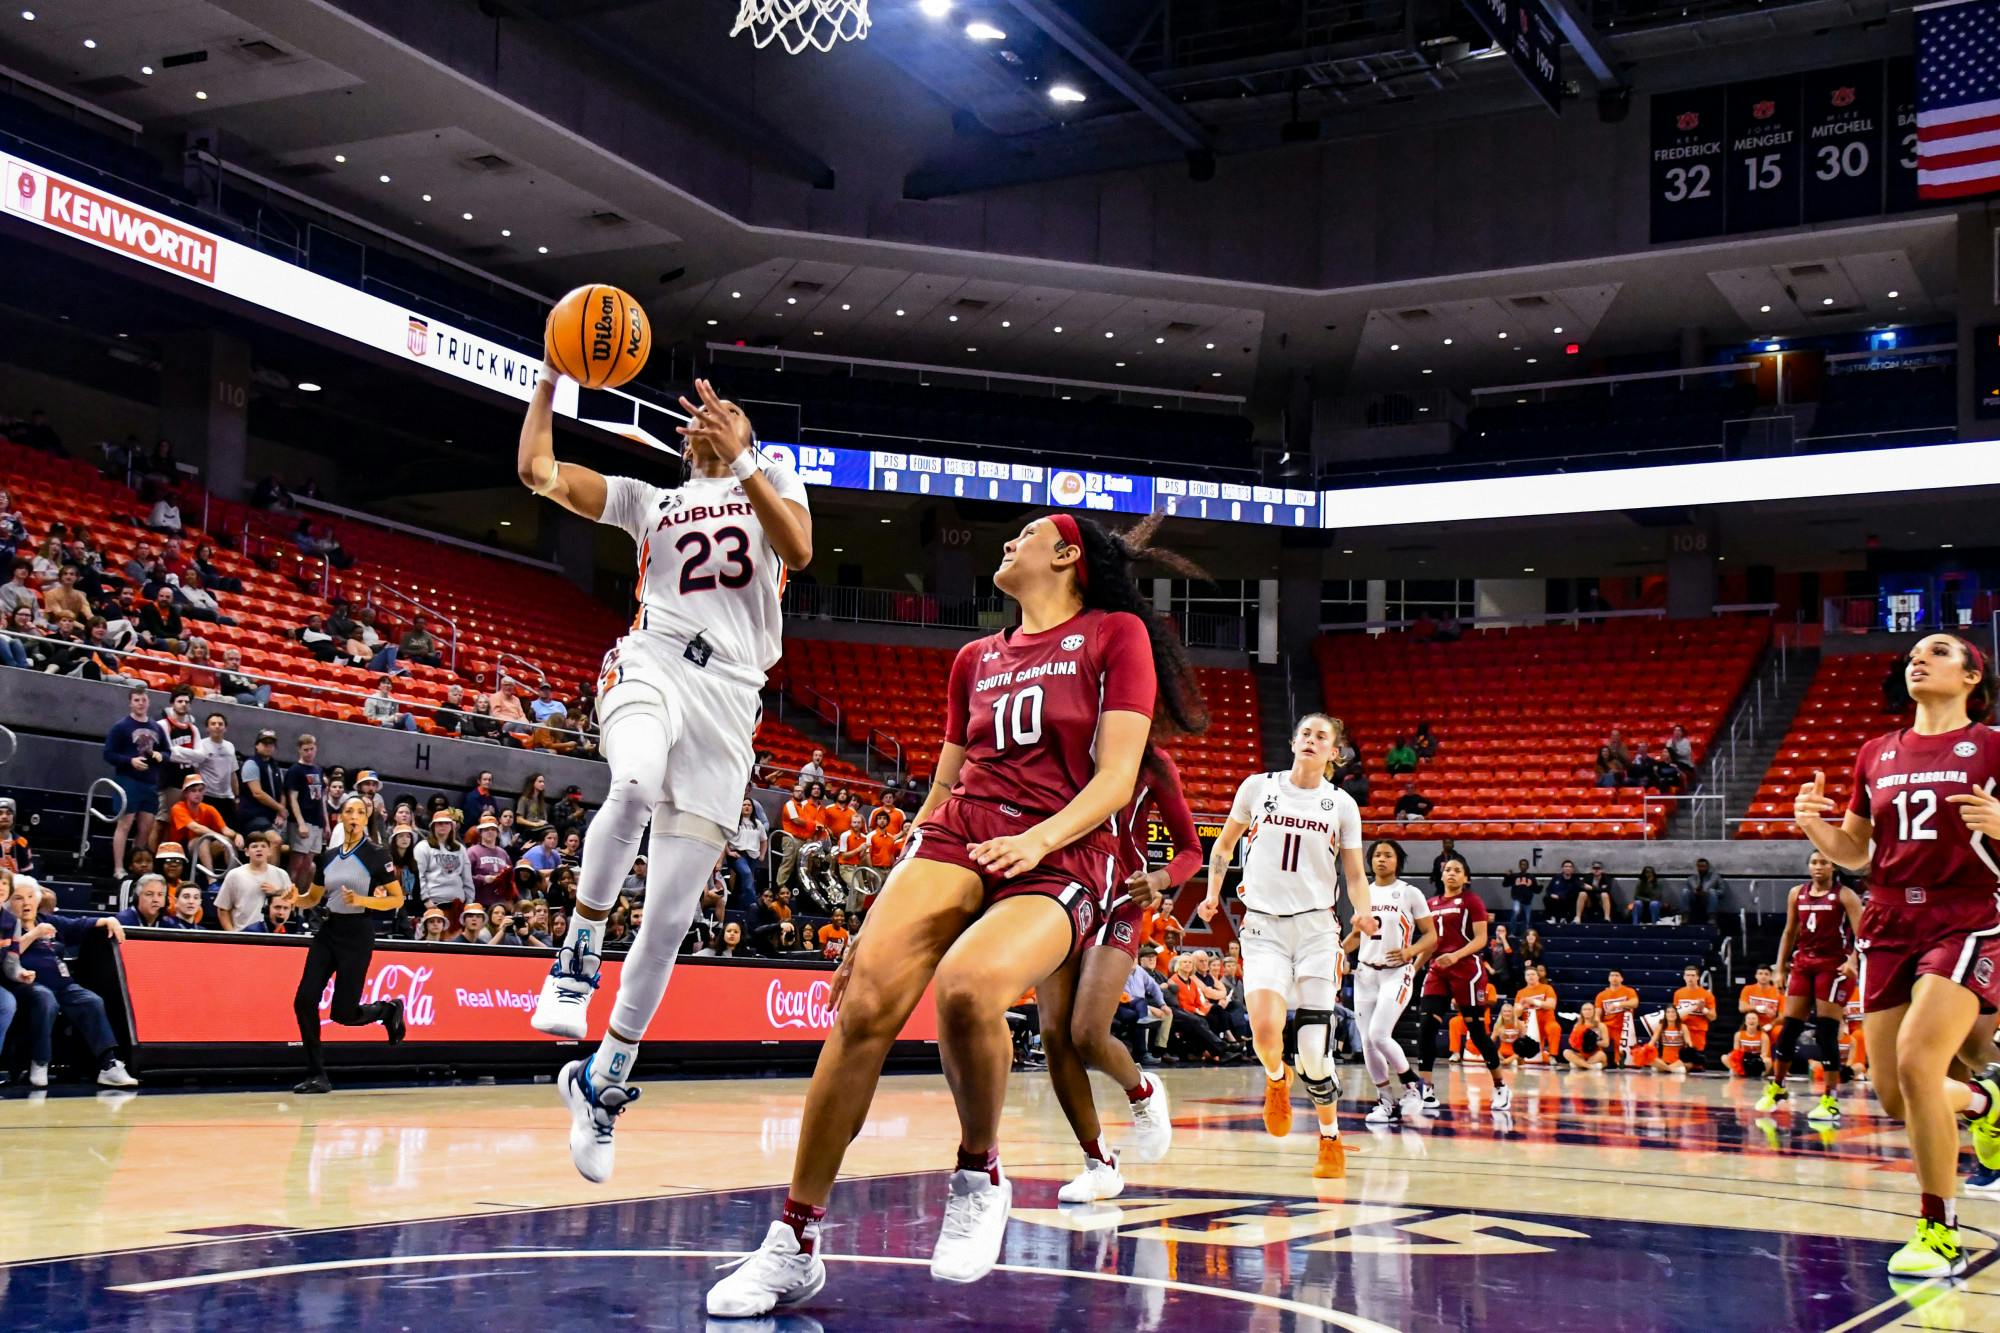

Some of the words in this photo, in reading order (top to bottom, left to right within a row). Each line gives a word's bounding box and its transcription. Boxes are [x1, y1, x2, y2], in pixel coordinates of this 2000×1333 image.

[1811, 119, 1873, 138] MITCHELL
[1734, 130, 1795, 151] MENGELT
[1899, 133, 1918, 169] 3
[1654, 142, 1721, 162] FREDERICK
[1815, 141, 1870, 181] 30
[1664, 164, 1712, 202] 32
[1744, 154, 1783, 191] 15
[50, 186, 213, 275] KENWORTH
[592, 295, 614, 363] Wilson
[627, 307, 642, 358] NCAA
[883, 455, 899, 468] PTS
[913, 457, 937, 471] FOULS
[1165, 480, 1179, 493] PTS
[1193, 482, 1216, 496] FOULS
[1167, 496, 1176, 515] 5
[1200, 498, 1207, 518] 1
[941, 528, 972, 545] 109
[674, 525, 754, 595] 23
[975, 672, 1013, 692] SOUTH
[1016, 661, 1077, 682] CAROLINA
[992, 685, 1043, 750] 10
[416, 743, 430, 770] H
[1876, 774, 1907, 789] SOUTH
[1909, 770, 1968, 784] CAROLINA
[1263, 814, 1329, 833] AUBURN
[1892, 789, 1938, 840] 12
[1166, 846, 1175, 860] 3
[1281, 833, 1302, 872] 11
[1532, 847, 1543, 867] F
[1371, 904, 1399, 913] BURN
[1437, 915, 1444, 937] 1
[1806, 912, 1818, 932] 4
[455, 988, 494, 1008] Real
[766, 978, 840, 1029] Coca-Co
